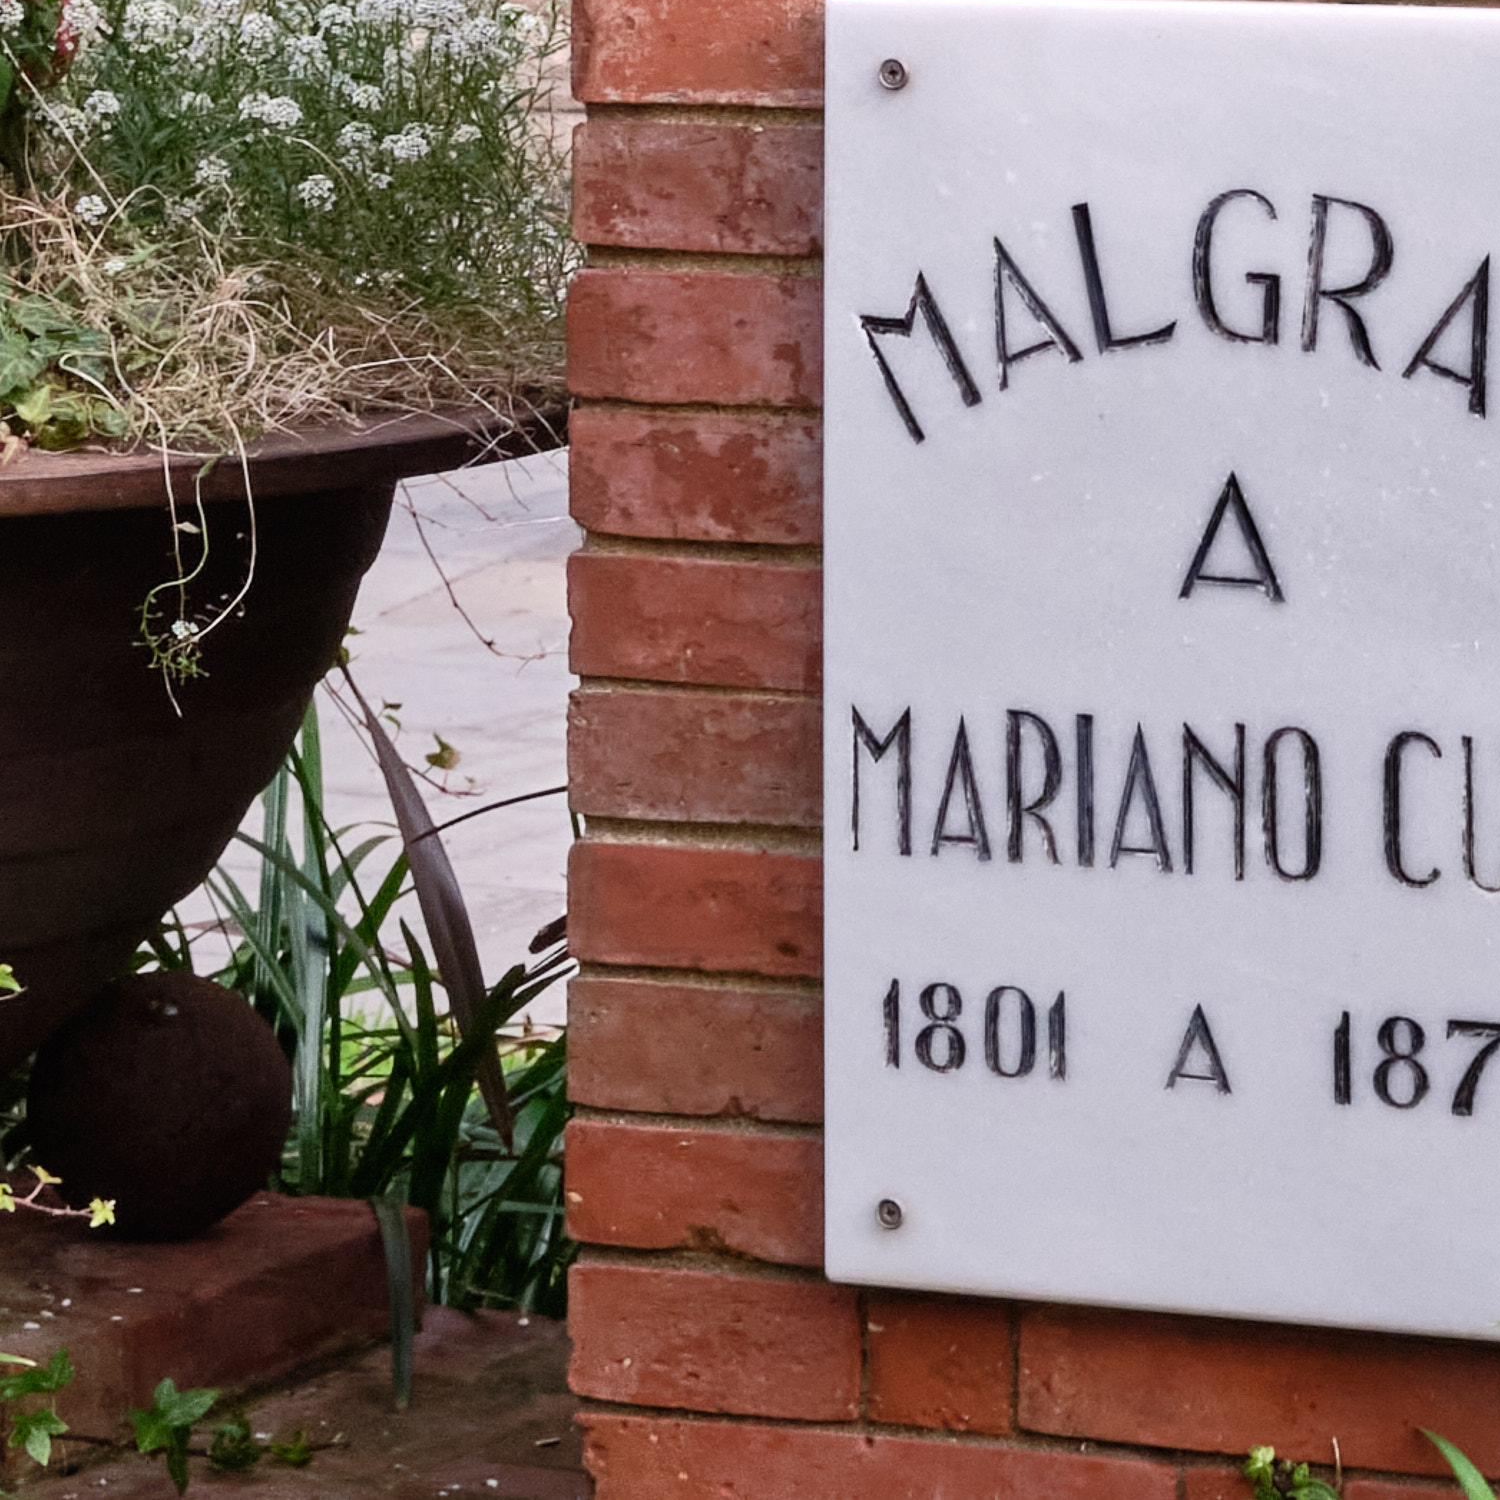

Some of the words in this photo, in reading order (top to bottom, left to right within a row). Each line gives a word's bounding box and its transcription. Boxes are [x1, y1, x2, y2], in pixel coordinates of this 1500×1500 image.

[1179, 471, 1286, 604] A
[850, 704, 1324, 882] MARIANO
[882, 977, 1068, 1083] 1801
[1164, 1002, 1233, 1095] A
